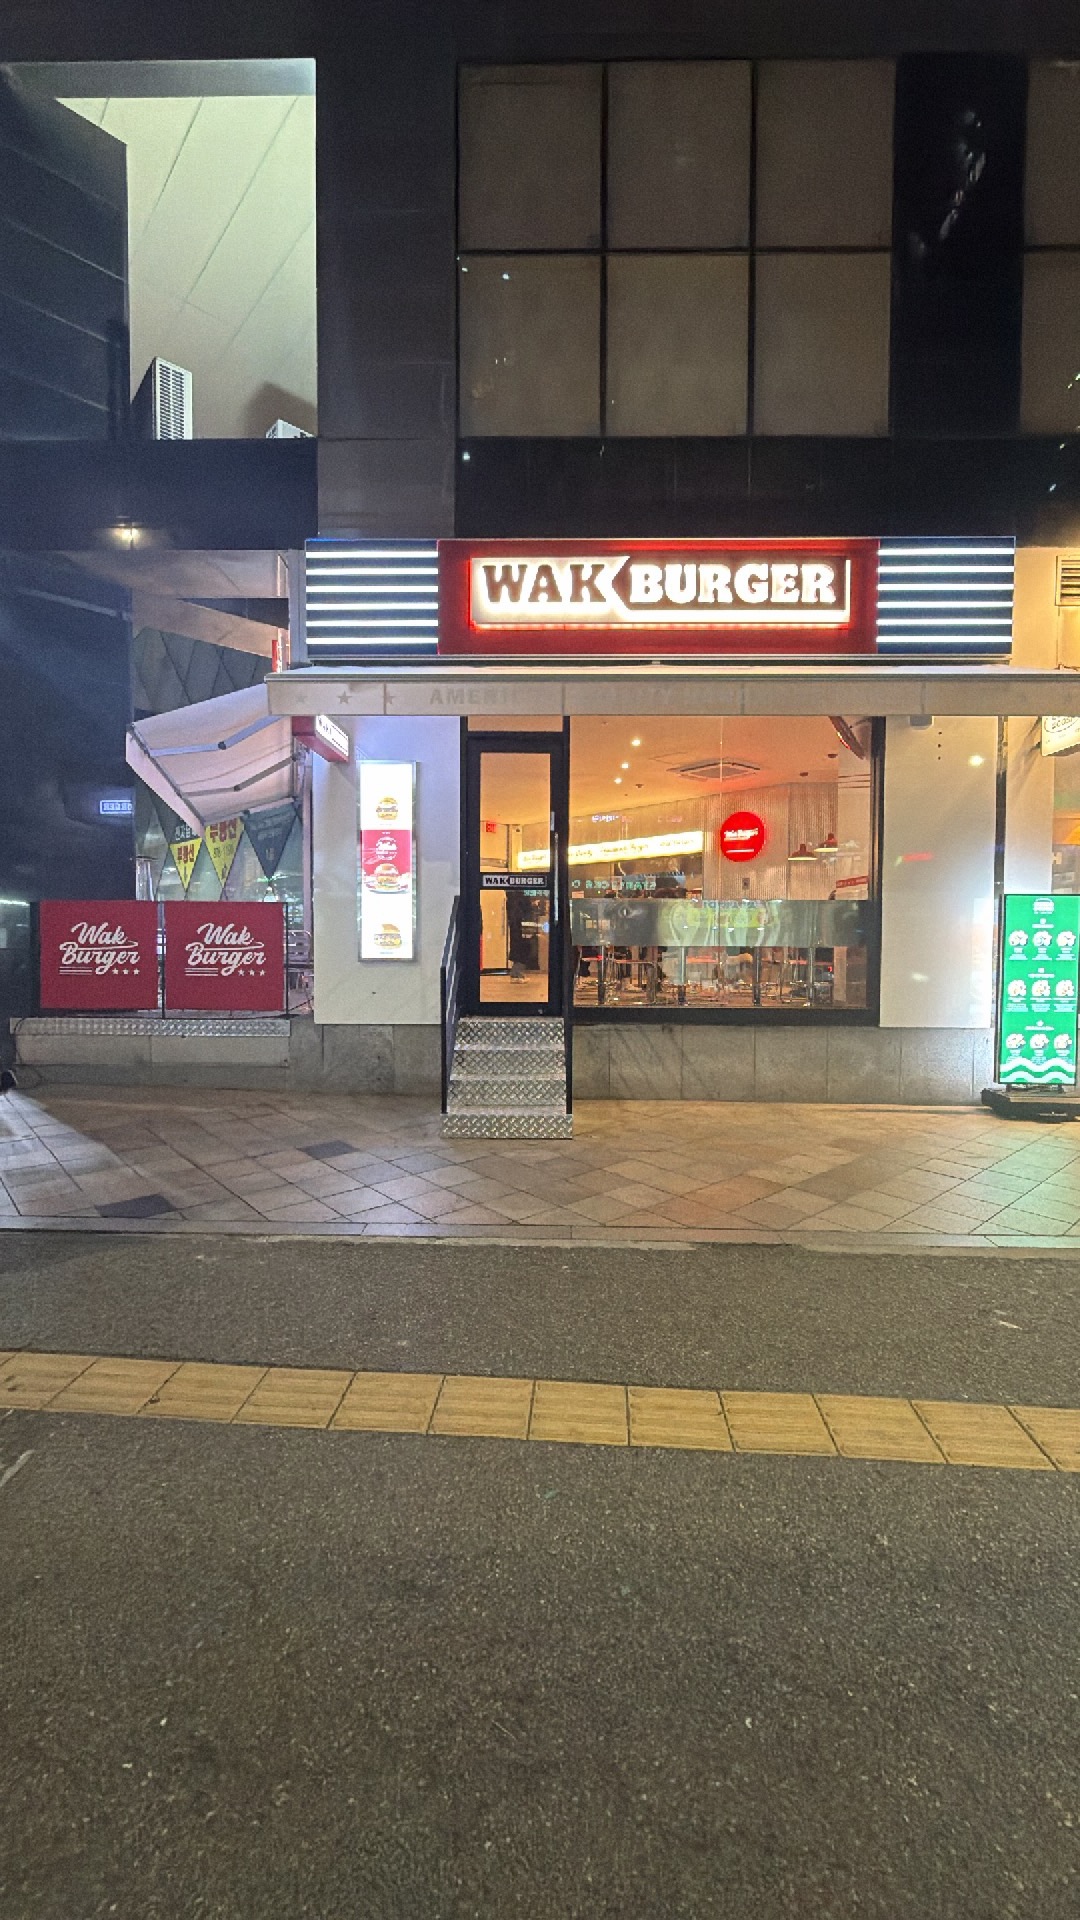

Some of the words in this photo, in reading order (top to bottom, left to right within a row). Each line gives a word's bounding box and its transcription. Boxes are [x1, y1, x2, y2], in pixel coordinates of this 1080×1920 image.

[482, 564, 607, 603] WAK
[629, 563, 837, 604] BURGER
[485, 877, 509, 885] WAK
[510, 877, 544, 885] BURGER
[71, 922, 128, 945] Wak
[197, 923, 253, 945] Wak
[59, 942, 141, 975] Burger
[185, 943, 267, 976] Burger
